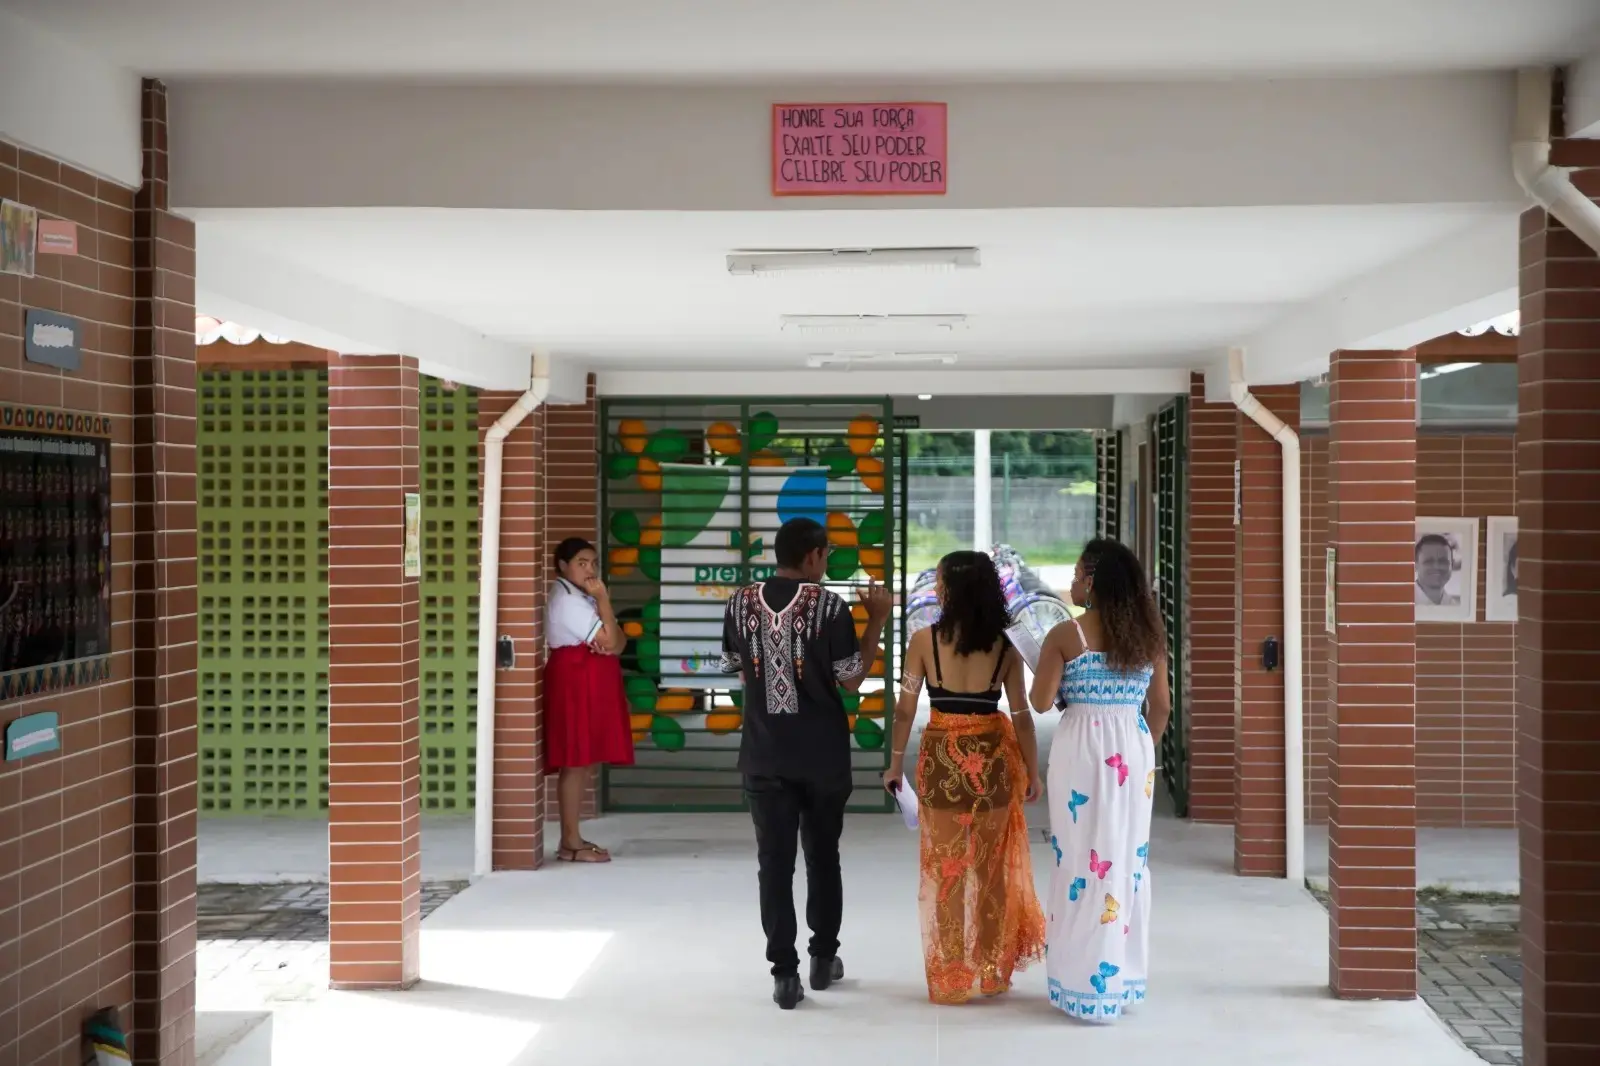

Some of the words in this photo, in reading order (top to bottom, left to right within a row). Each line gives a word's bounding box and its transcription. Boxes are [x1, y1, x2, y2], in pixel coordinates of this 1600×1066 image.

[782, 108, 825, 128] HONRE
[834, 108, 864, 128] SUA
[872, 108, 914, 130] FORÇA
[783, 134, 834, 156] EXALTE
[841, 134, 871, 156] SEU
[875, 135, 926, 156] PODER
[781, 159, 847, 183] CELEBRE
[854, 160, 885, 183] SEU
[889, 160, 942, 183] PODER
